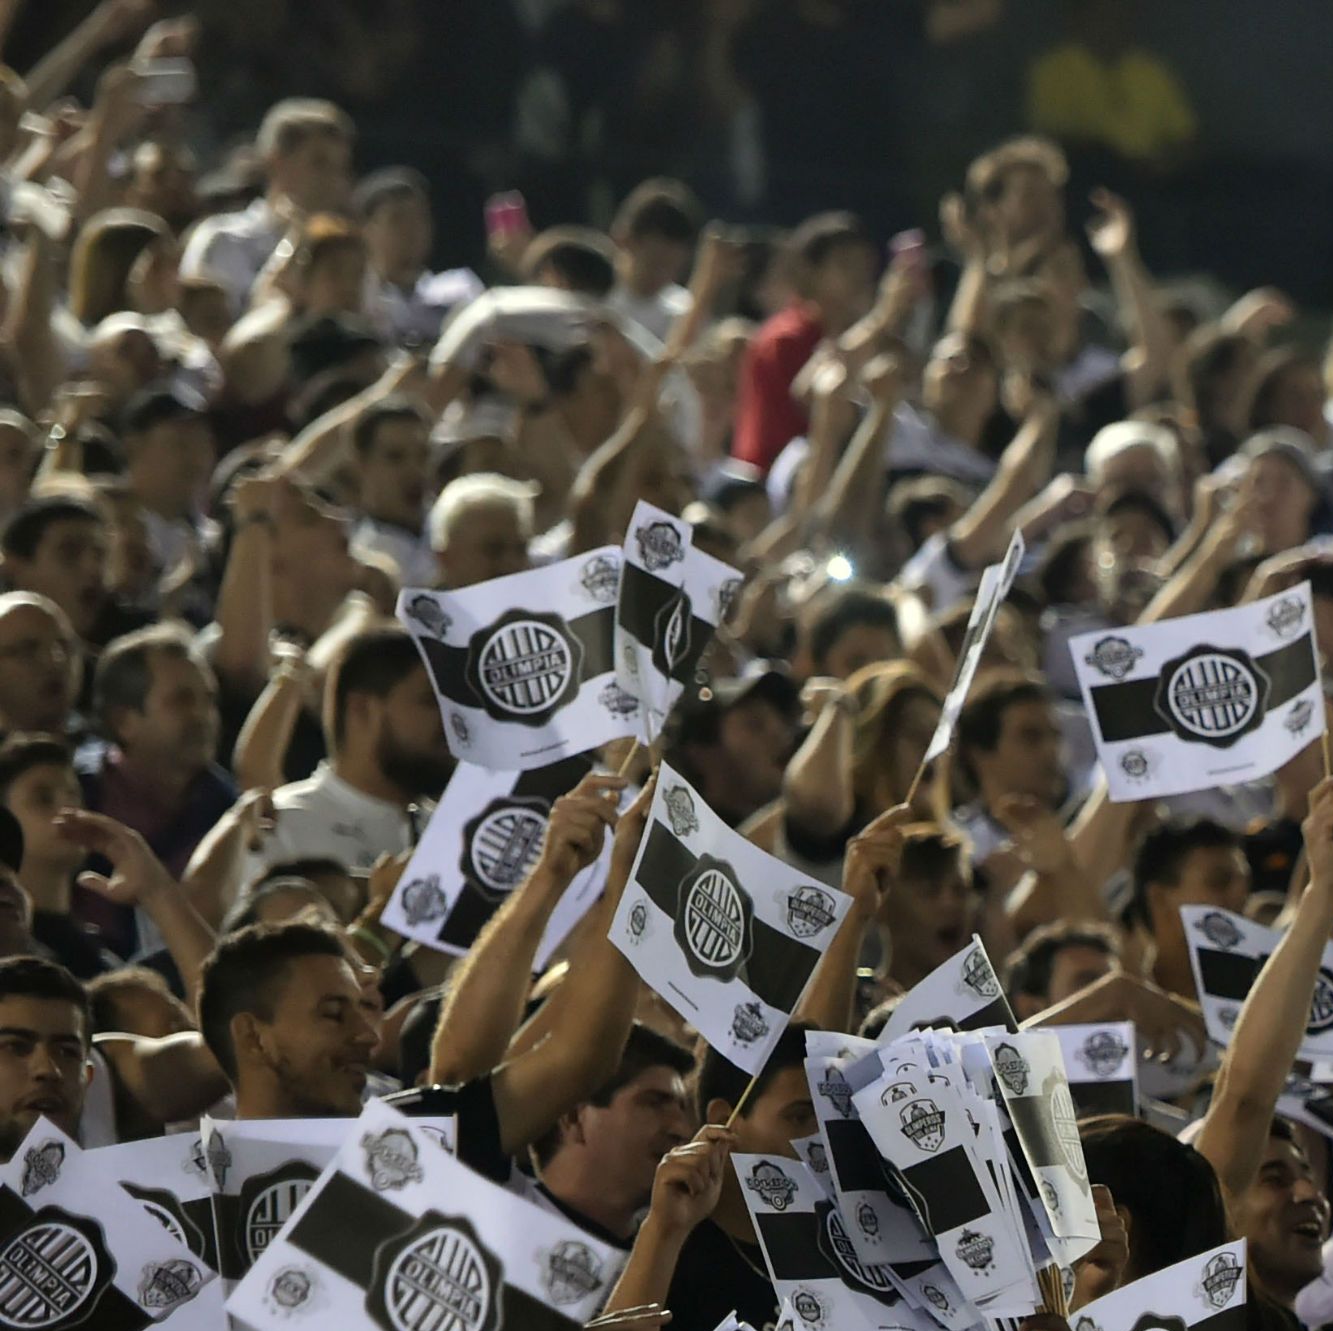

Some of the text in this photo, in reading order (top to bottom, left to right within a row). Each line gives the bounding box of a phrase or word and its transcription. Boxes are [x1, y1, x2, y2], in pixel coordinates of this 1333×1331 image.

[489, 654, 562, 682] OLIMPIA
[695, 894, 737, 943] OLIMPIA
[9, 1248, 70, 1308] OLIMPIA
[404, 1260, 477, 1318] OLIMPIA
